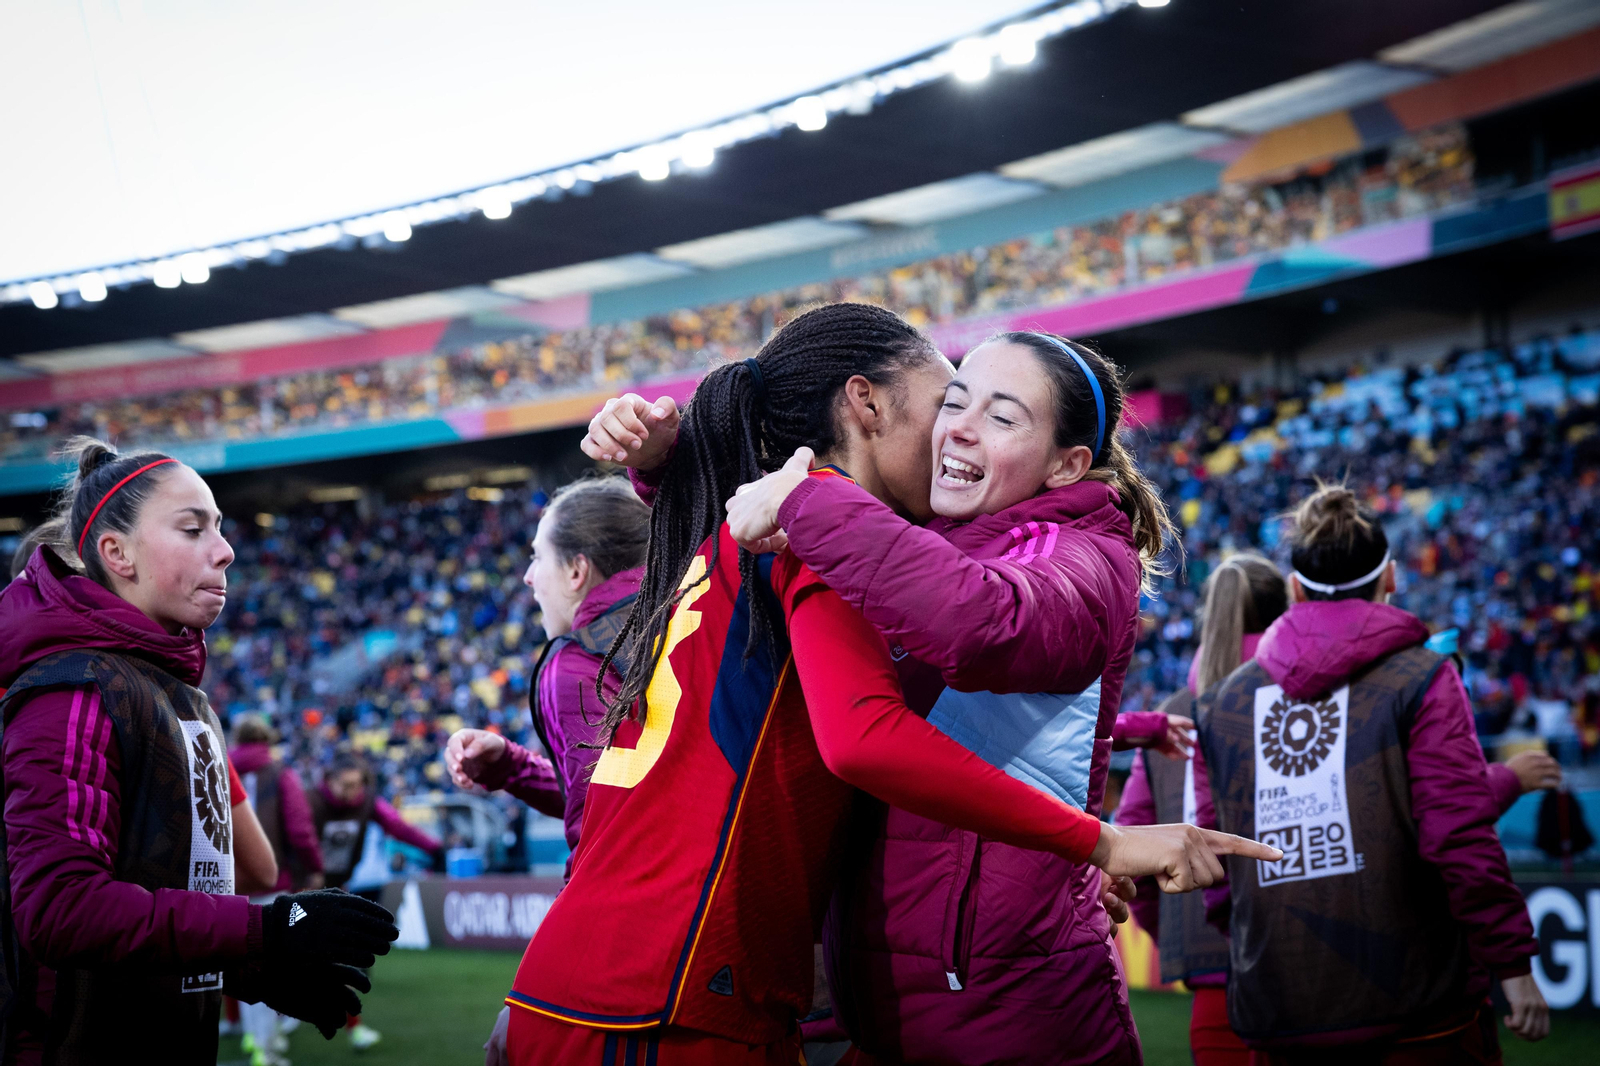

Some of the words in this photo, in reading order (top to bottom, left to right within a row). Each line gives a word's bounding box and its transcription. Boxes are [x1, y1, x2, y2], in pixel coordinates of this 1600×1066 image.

[1260, 786, 1288, 801] FIFA
[1260, 808, 1303, 826] WORLD
[1305, 802, 1329, 818] CUP
[1309, 823, 1345, 847] 20
[194, 861, 220, 877] FIFA
[1262, 851, 1303, 880] NZ
[1311, 846, 1349, 870] 23
[288, 901, 298, 927] adidas
